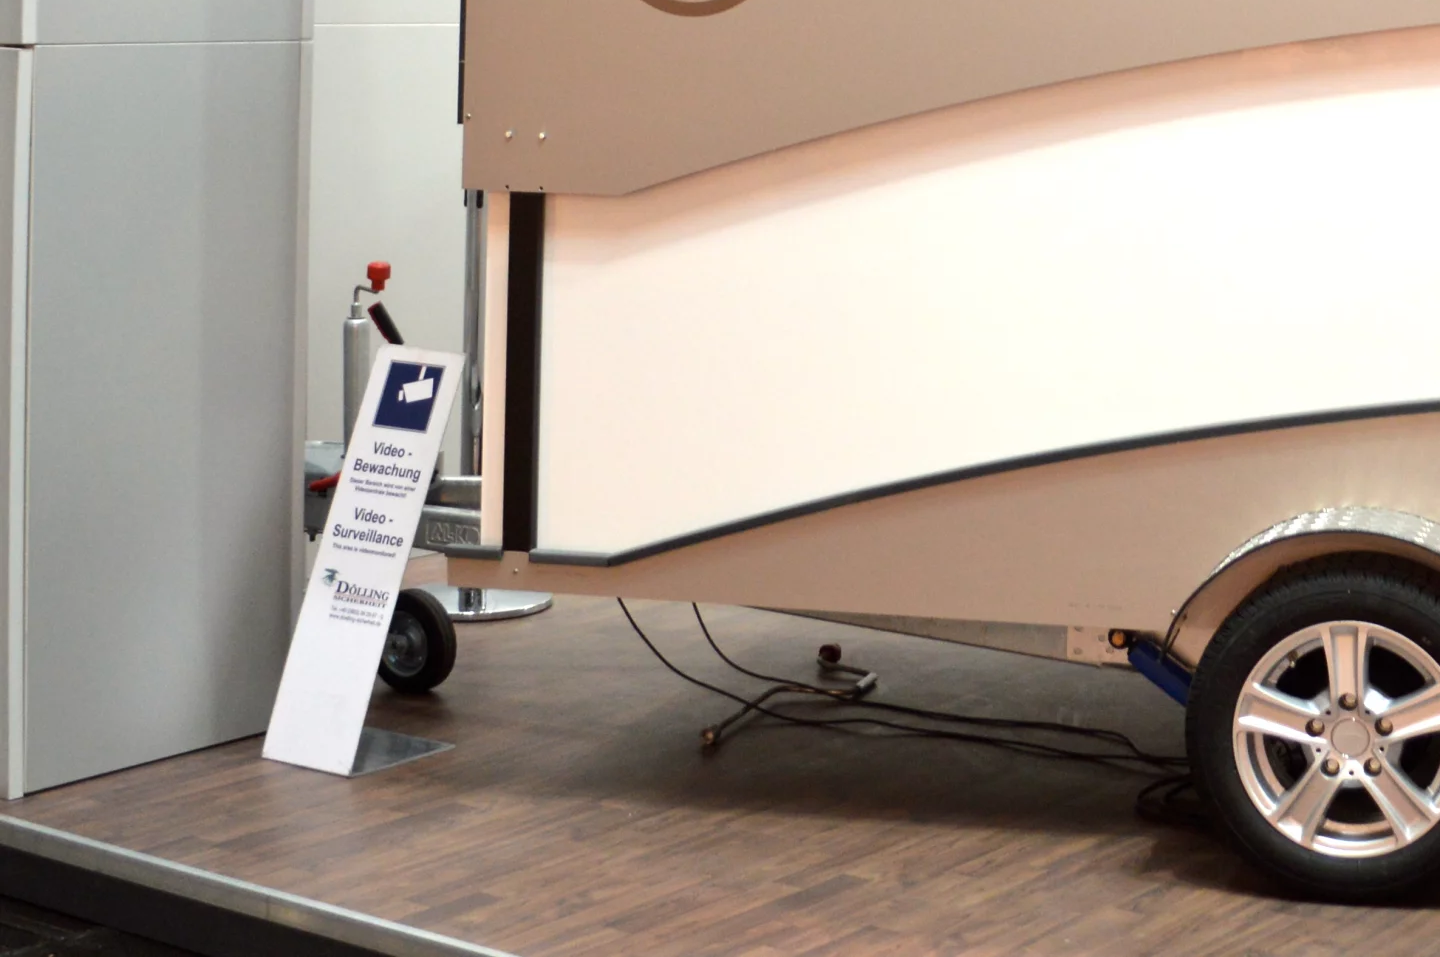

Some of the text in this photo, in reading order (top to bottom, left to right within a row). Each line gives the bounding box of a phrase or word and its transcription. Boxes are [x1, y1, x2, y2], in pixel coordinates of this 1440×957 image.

[373, 441, 405, 458] Video
[353, 458, 421, 483] Bewachung
[354, 507, 386, 524] Video
[332, 523, 404, 547] Surveillance
